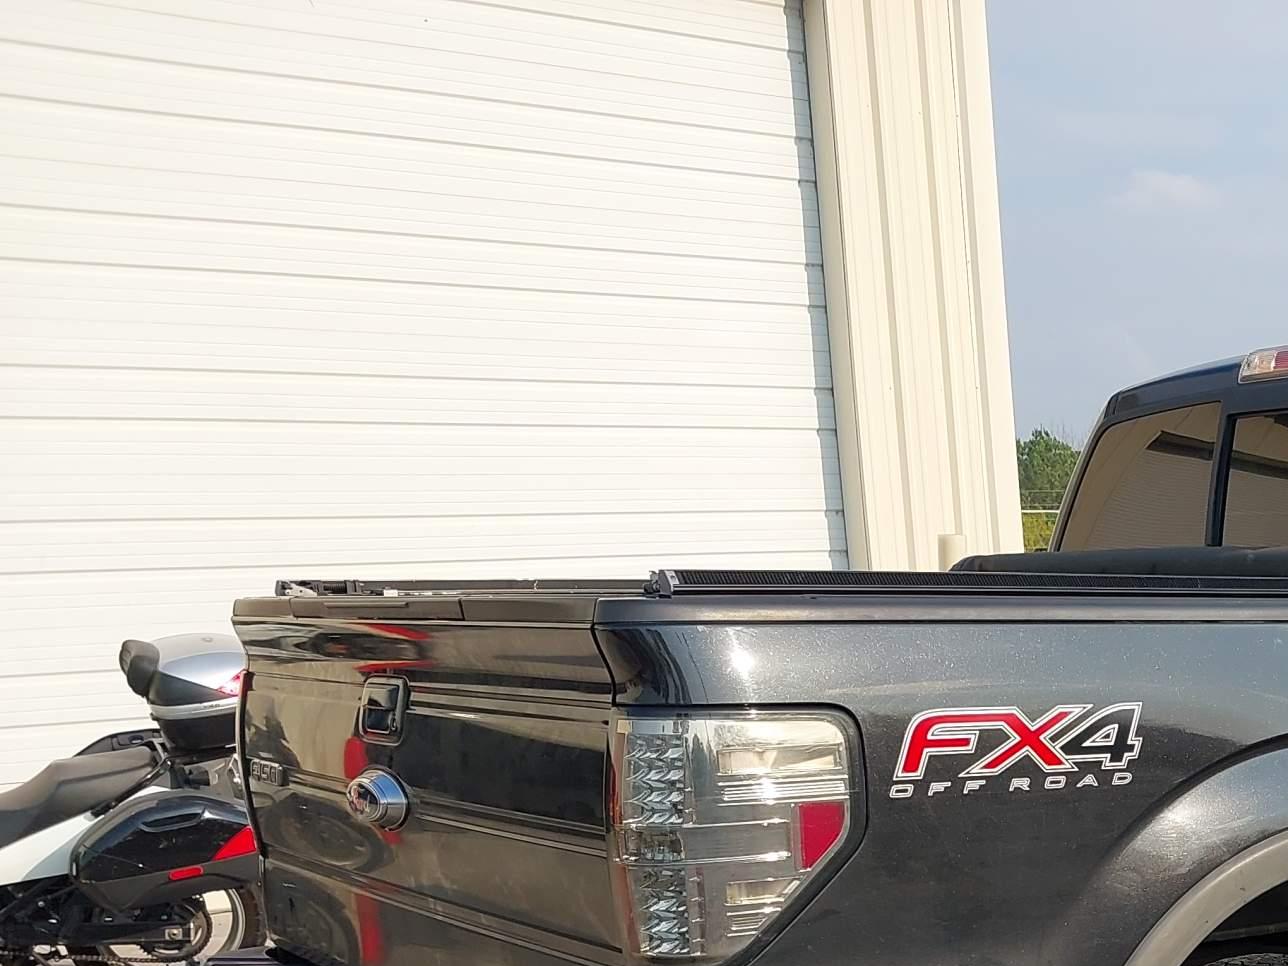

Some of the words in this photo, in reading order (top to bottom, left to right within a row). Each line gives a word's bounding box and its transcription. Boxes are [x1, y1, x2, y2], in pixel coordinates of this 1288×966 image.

[892, 701, 1143, 781] FX4
[888, 779, 987, 799] OFF
[1008, 771, 1133, 792] ROAD
